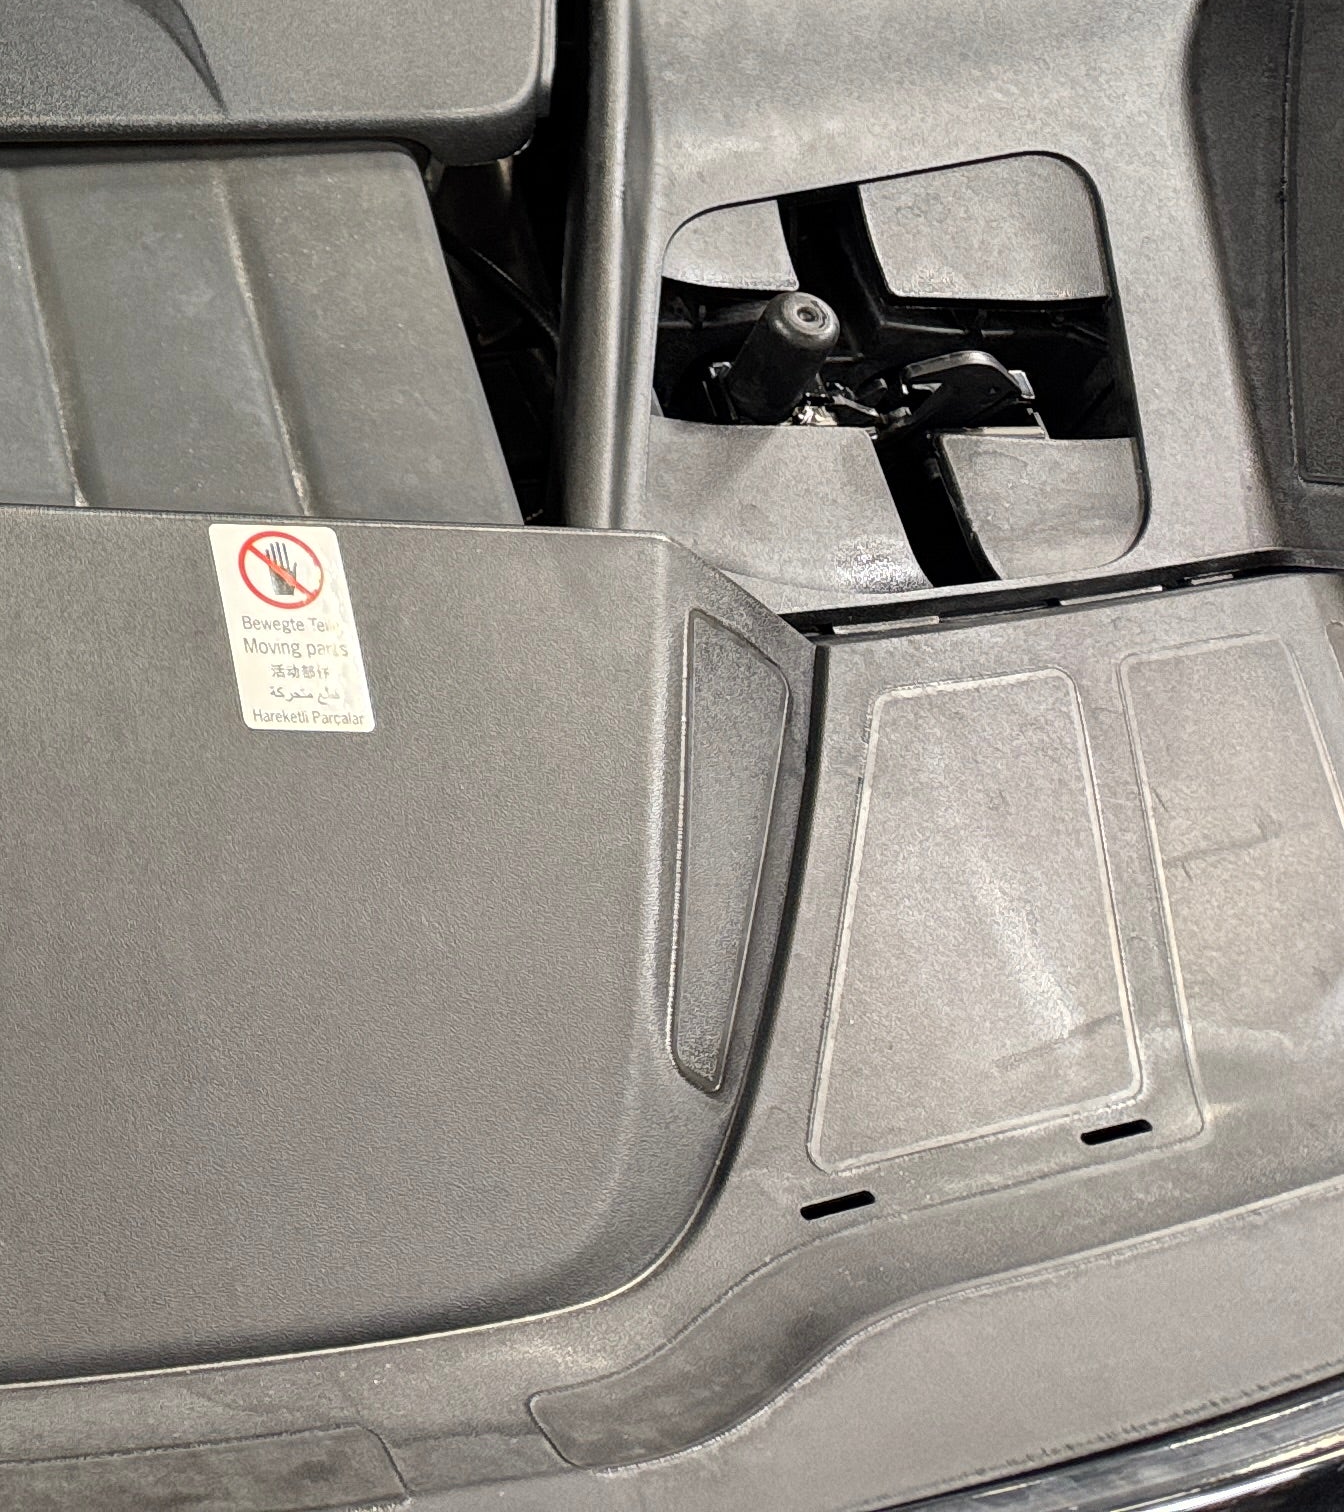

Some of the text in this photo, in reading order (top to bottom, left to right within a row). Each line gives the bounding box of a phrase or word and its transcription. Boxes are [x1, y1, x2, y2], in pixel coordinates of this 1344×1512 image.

[241, 615, 305, 634] Bewegte
[243, 637, 349, 659] Moving parts
[252, 708, 365, 726] Hareketli Parçalar
